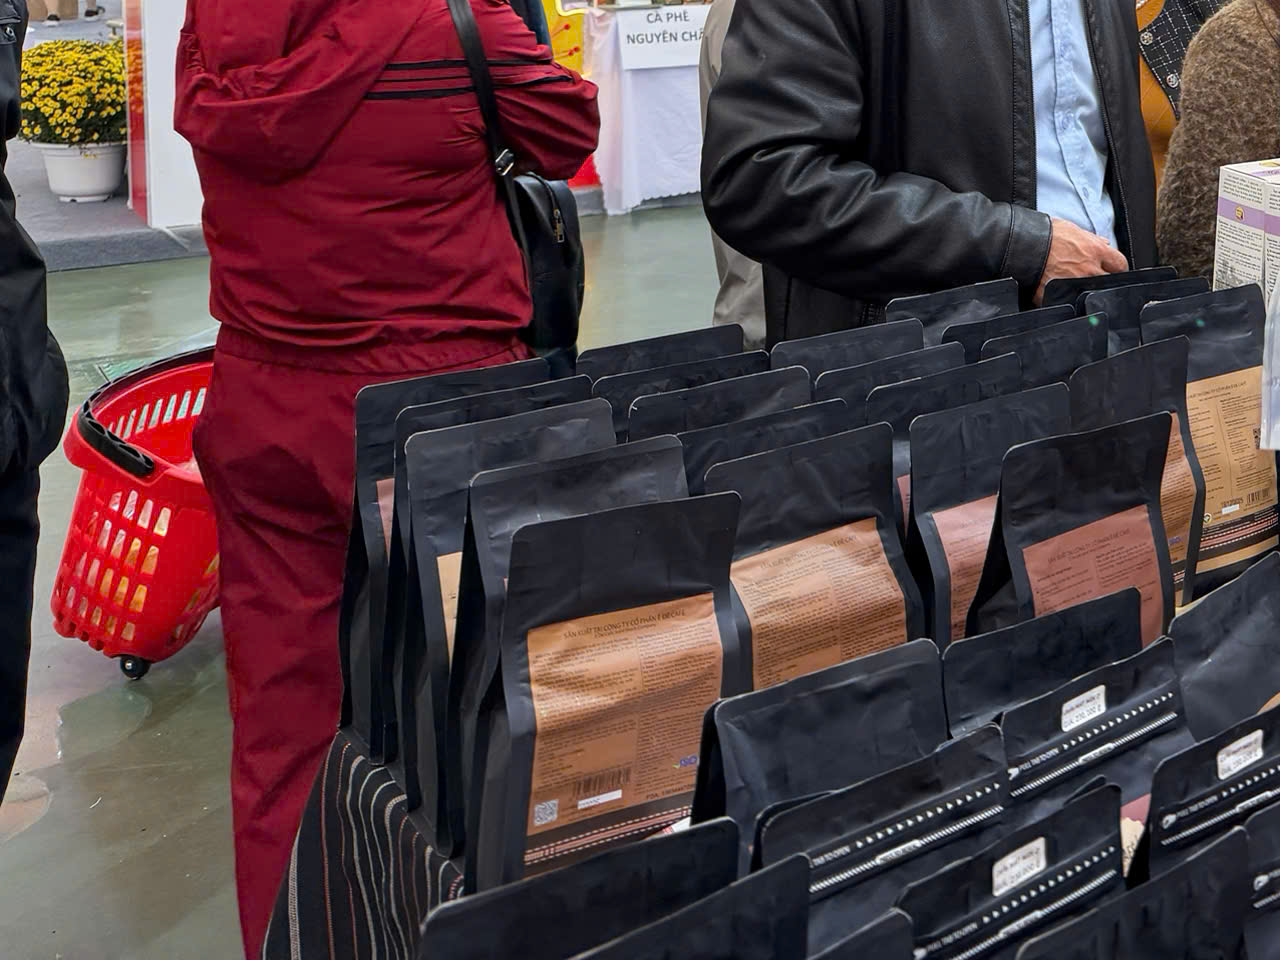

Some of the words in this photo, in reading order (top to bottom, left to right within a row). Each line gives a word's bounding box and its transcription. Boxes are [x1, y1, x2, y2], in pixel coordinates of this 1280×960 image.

[646, 10, 663, 24] CÀ
[666, 8, 690, 22] PHÊ
[626, 28, 678, 44] NGUYÊN
